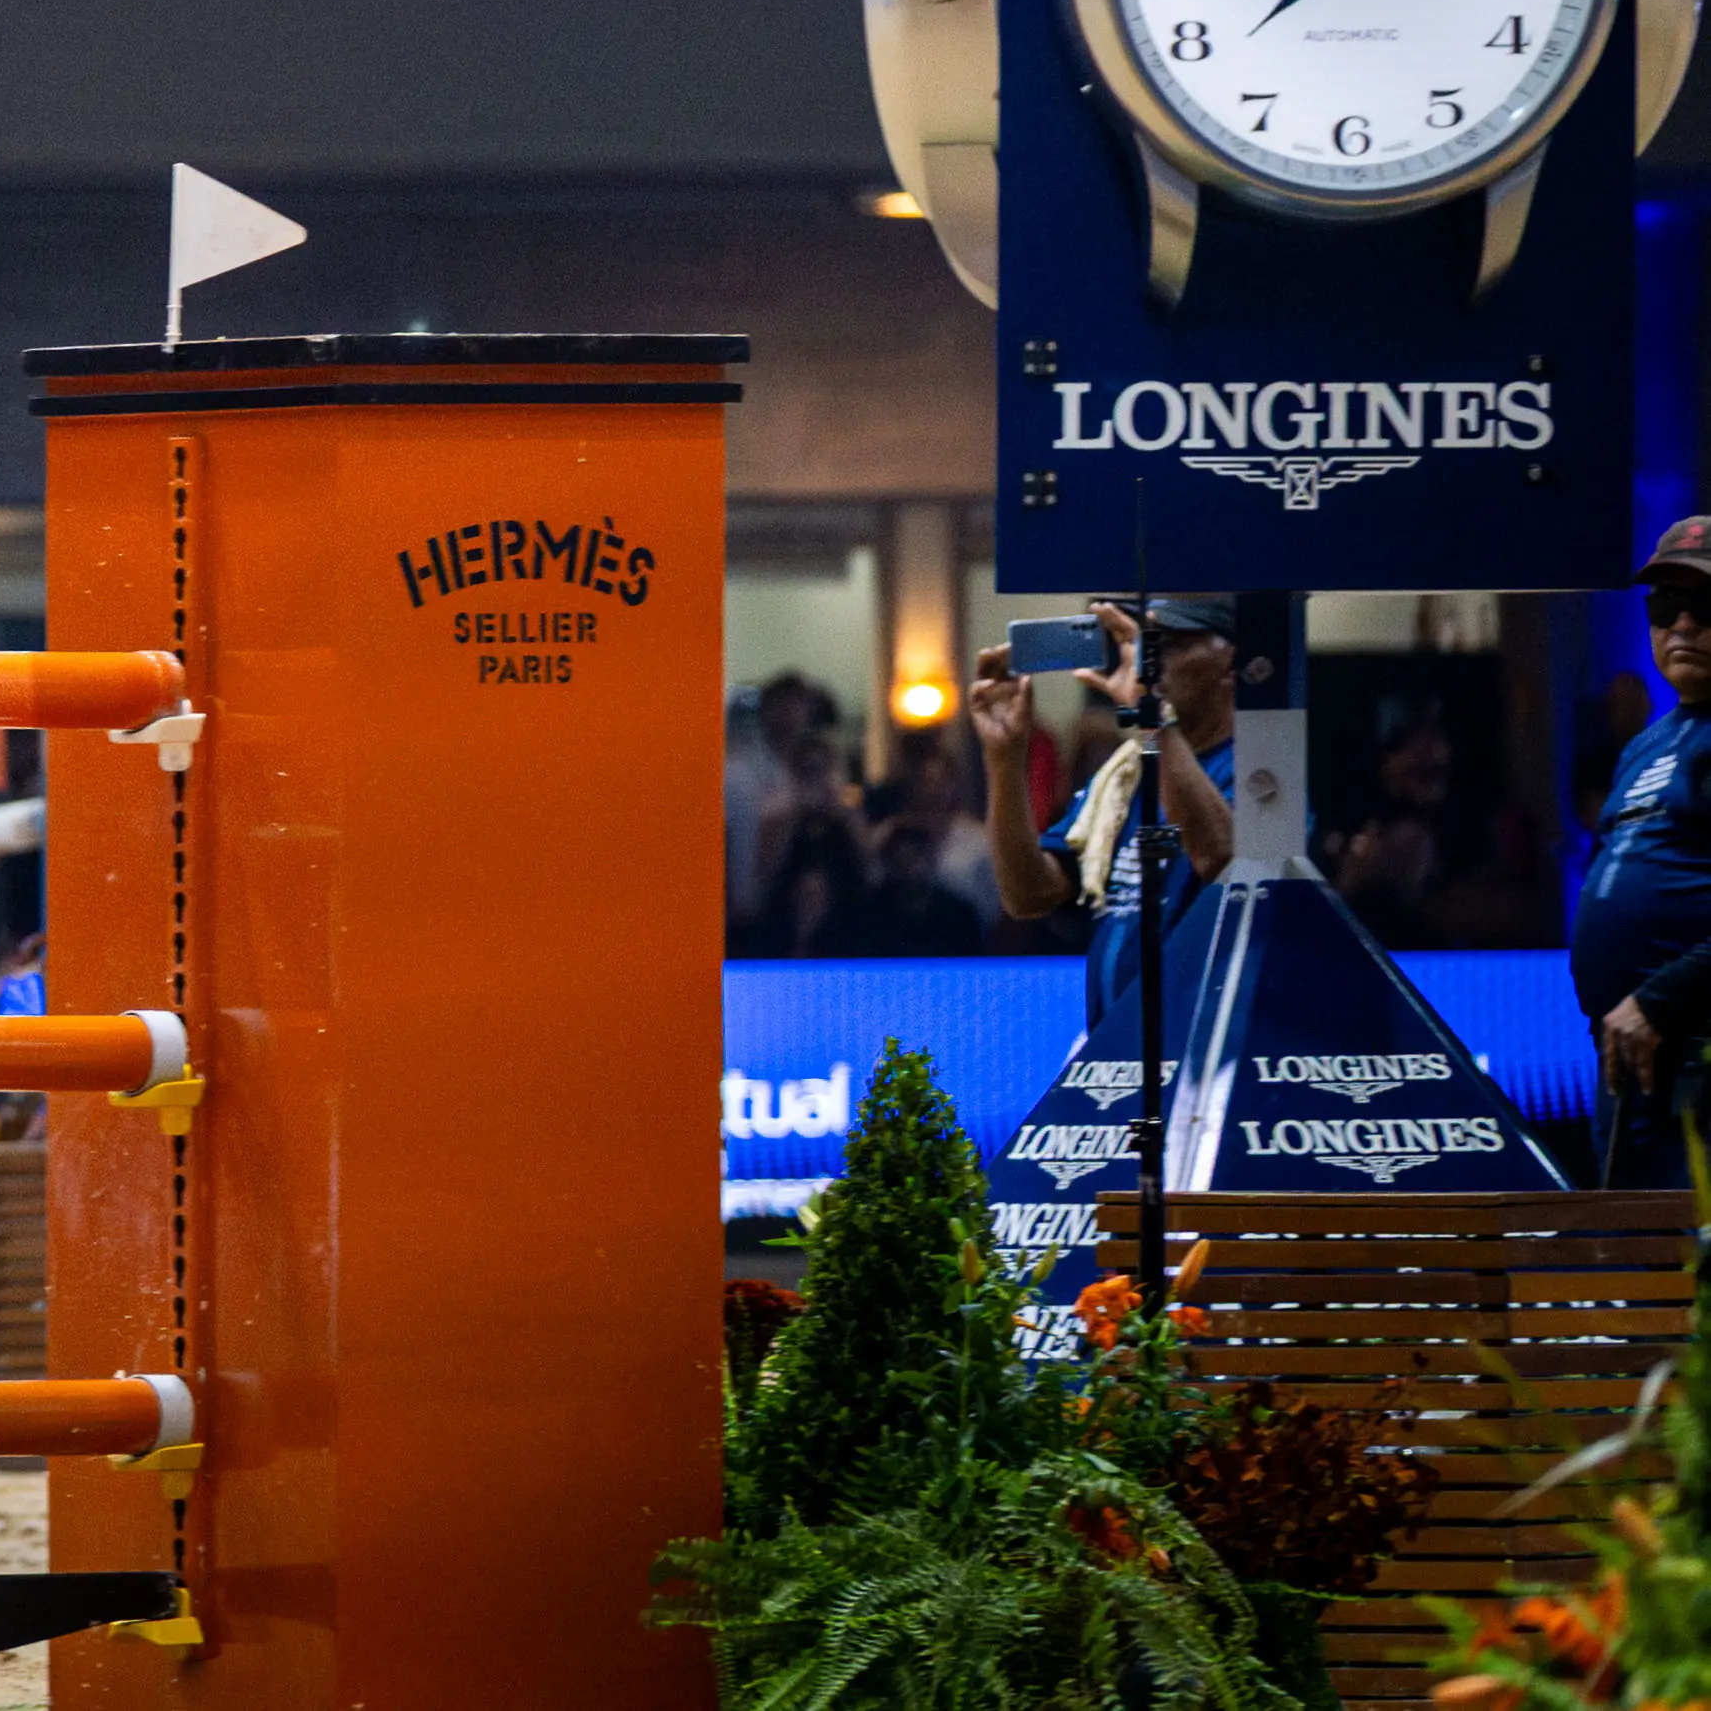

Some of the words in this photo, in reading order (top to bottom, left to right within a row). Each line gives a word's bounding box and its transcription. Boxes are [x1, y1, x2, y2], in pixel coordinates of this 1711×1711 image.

[1169, 19, 1213, 62] 8
[1302, 28, 1401, 42] AUTOMATIC
[1483, 14, 1532, 55] 4
[1239, 92, 1280, 132] 7
[1424, 87, 1465, 129] 5
[1332, 114, 1373, 157] 6
[1052, 381, 1556, 451] LONGINES
[397, 515, 656, 609] HERMÈS
[453, 611, 598, 644] SELLIER
[478, 654, 573, 685] PARIS
[1251, 1053, 1453, 1084] LONGINES
[1238, 1116, 1505, 1156] LONGINES
